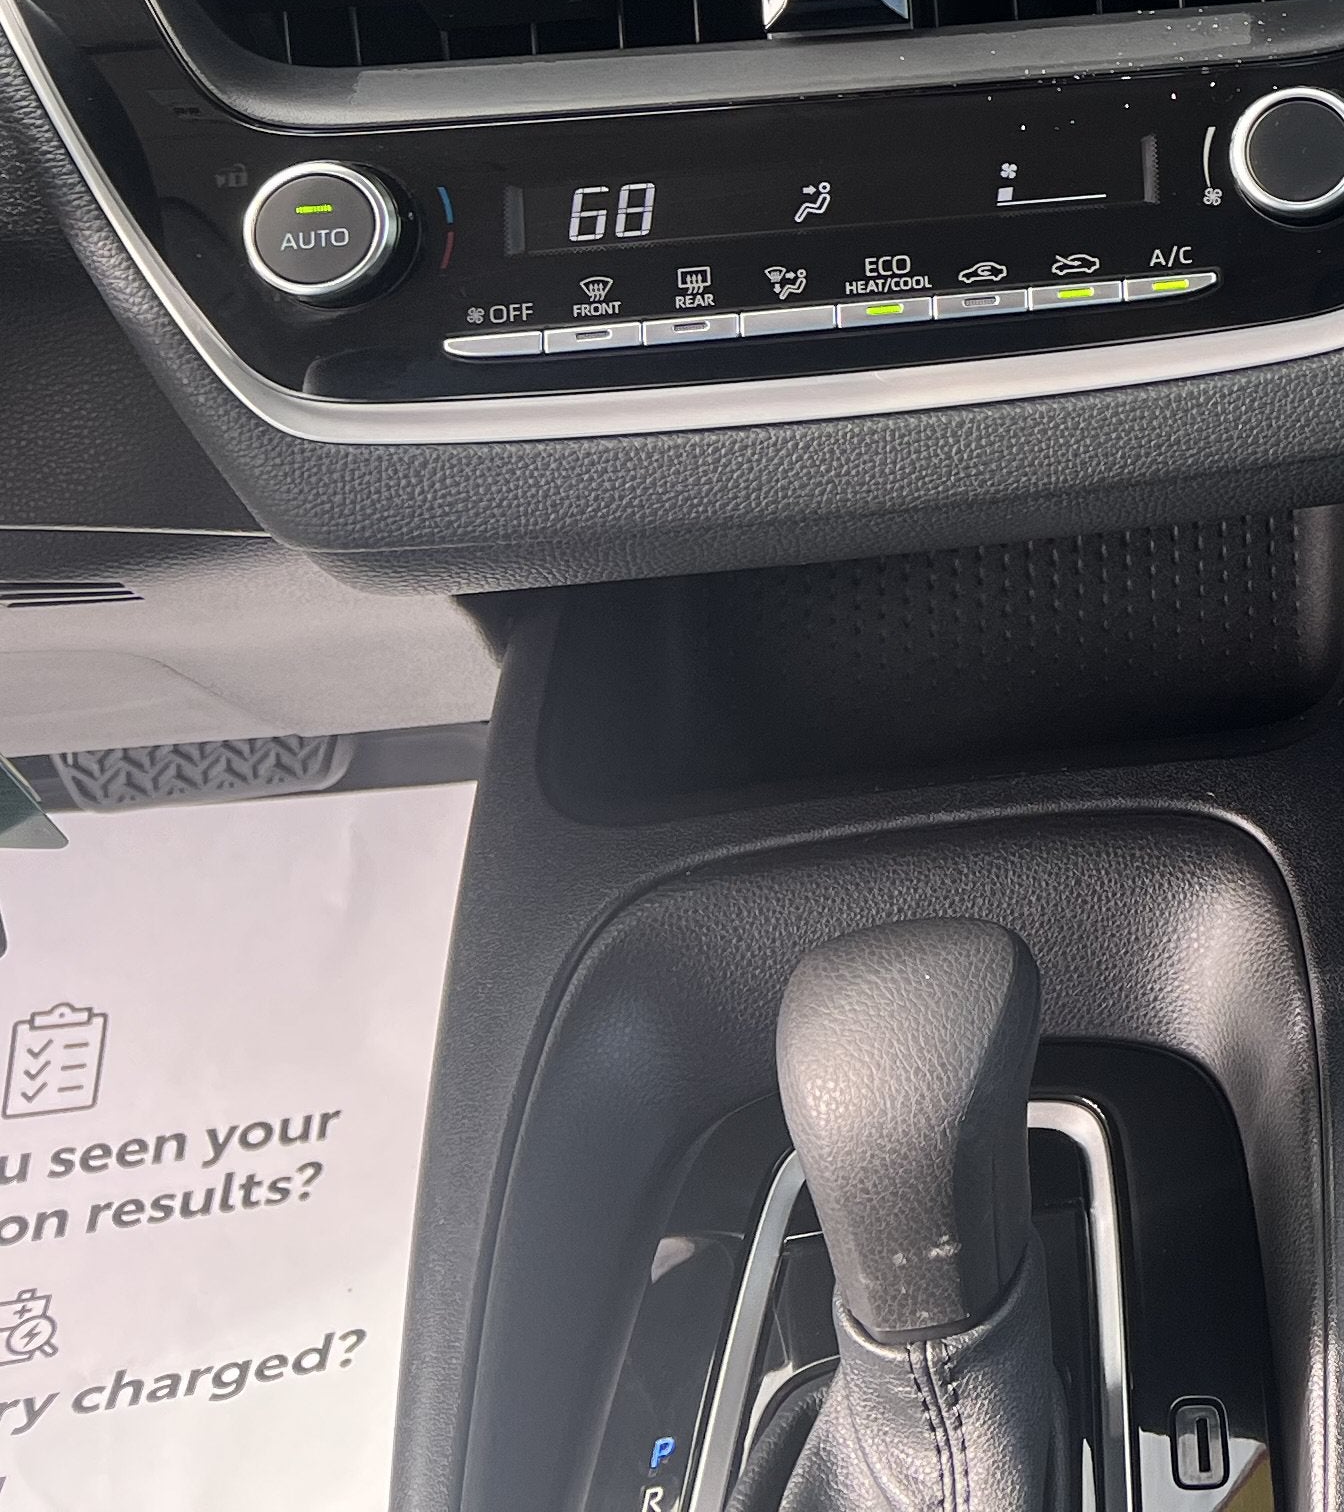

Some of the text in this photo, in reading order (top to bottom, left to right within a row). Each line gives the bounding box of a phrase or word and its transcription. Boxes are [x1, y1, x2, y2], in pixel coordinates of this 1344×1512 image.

[568, 182, 656, 242] 68
[280, 228, 350, 251] AUTO
[865, 255, 911, 277] ECO
[1150, 245, 1193, 268] A/C
[845, 275, 933, 296] HEAT/COOL
[572, 301, 622, 317] FRONT
[675, 293, 714, 309] REAR
[490, 303, 534, 324] OFF
[47, 1131, 188, 1179] seen
[201, 1109, 342, 1169] your
[85, 1160, 324, 1235] results?
[71, 1328, 367, 1415] charged?
[650, 1437, 676, 1468] P
[641, 1486, 664, 1512] R
